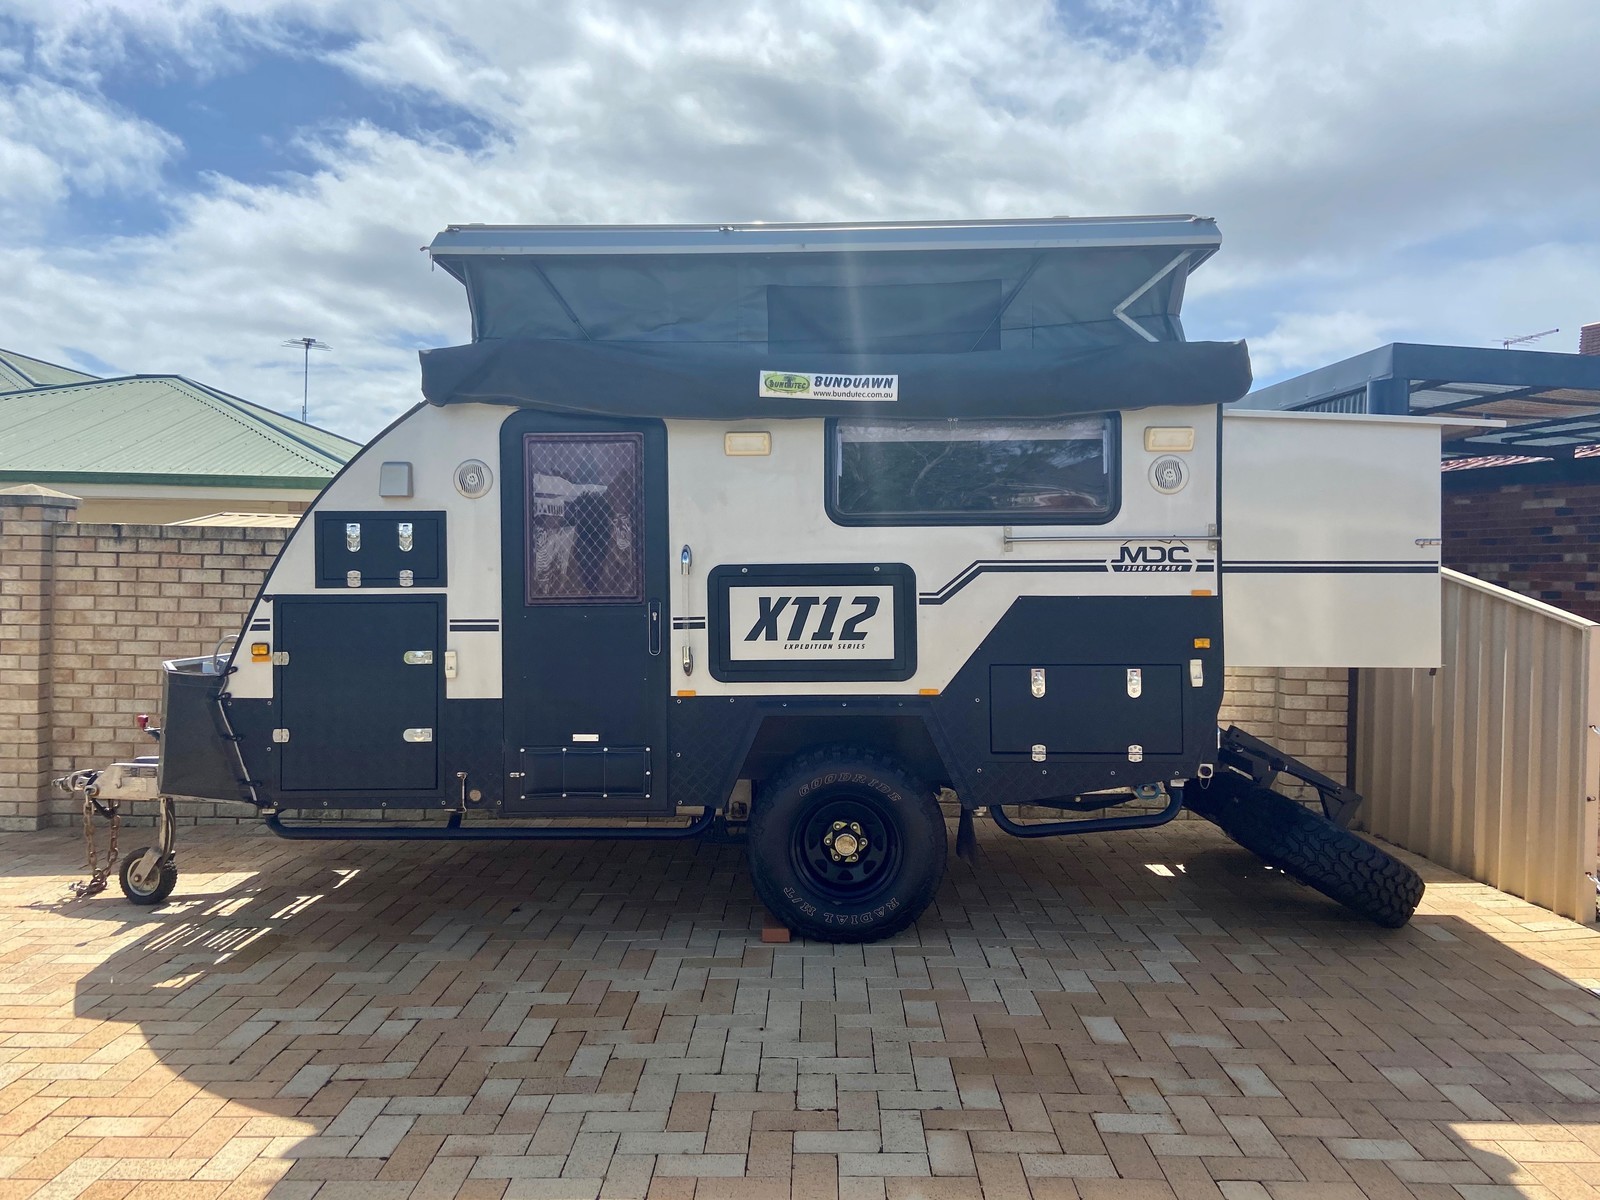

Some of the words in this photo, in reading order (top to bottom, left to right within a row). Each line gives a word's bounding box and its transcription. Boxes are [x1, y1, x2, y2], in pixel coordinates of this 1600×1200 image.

[813, 390, 893, 398] www.bundutec.com.au
[814, 376, 893, 388] BUNDUAWN
[1111, 546, 1192, 563] MDC
[744, 596, 880, 641] XT12
[799, 773, 902, 802] GOODRIDE
[783, 886, 816, 917] M/T
[824, 898, 900, 925] RADIAL
